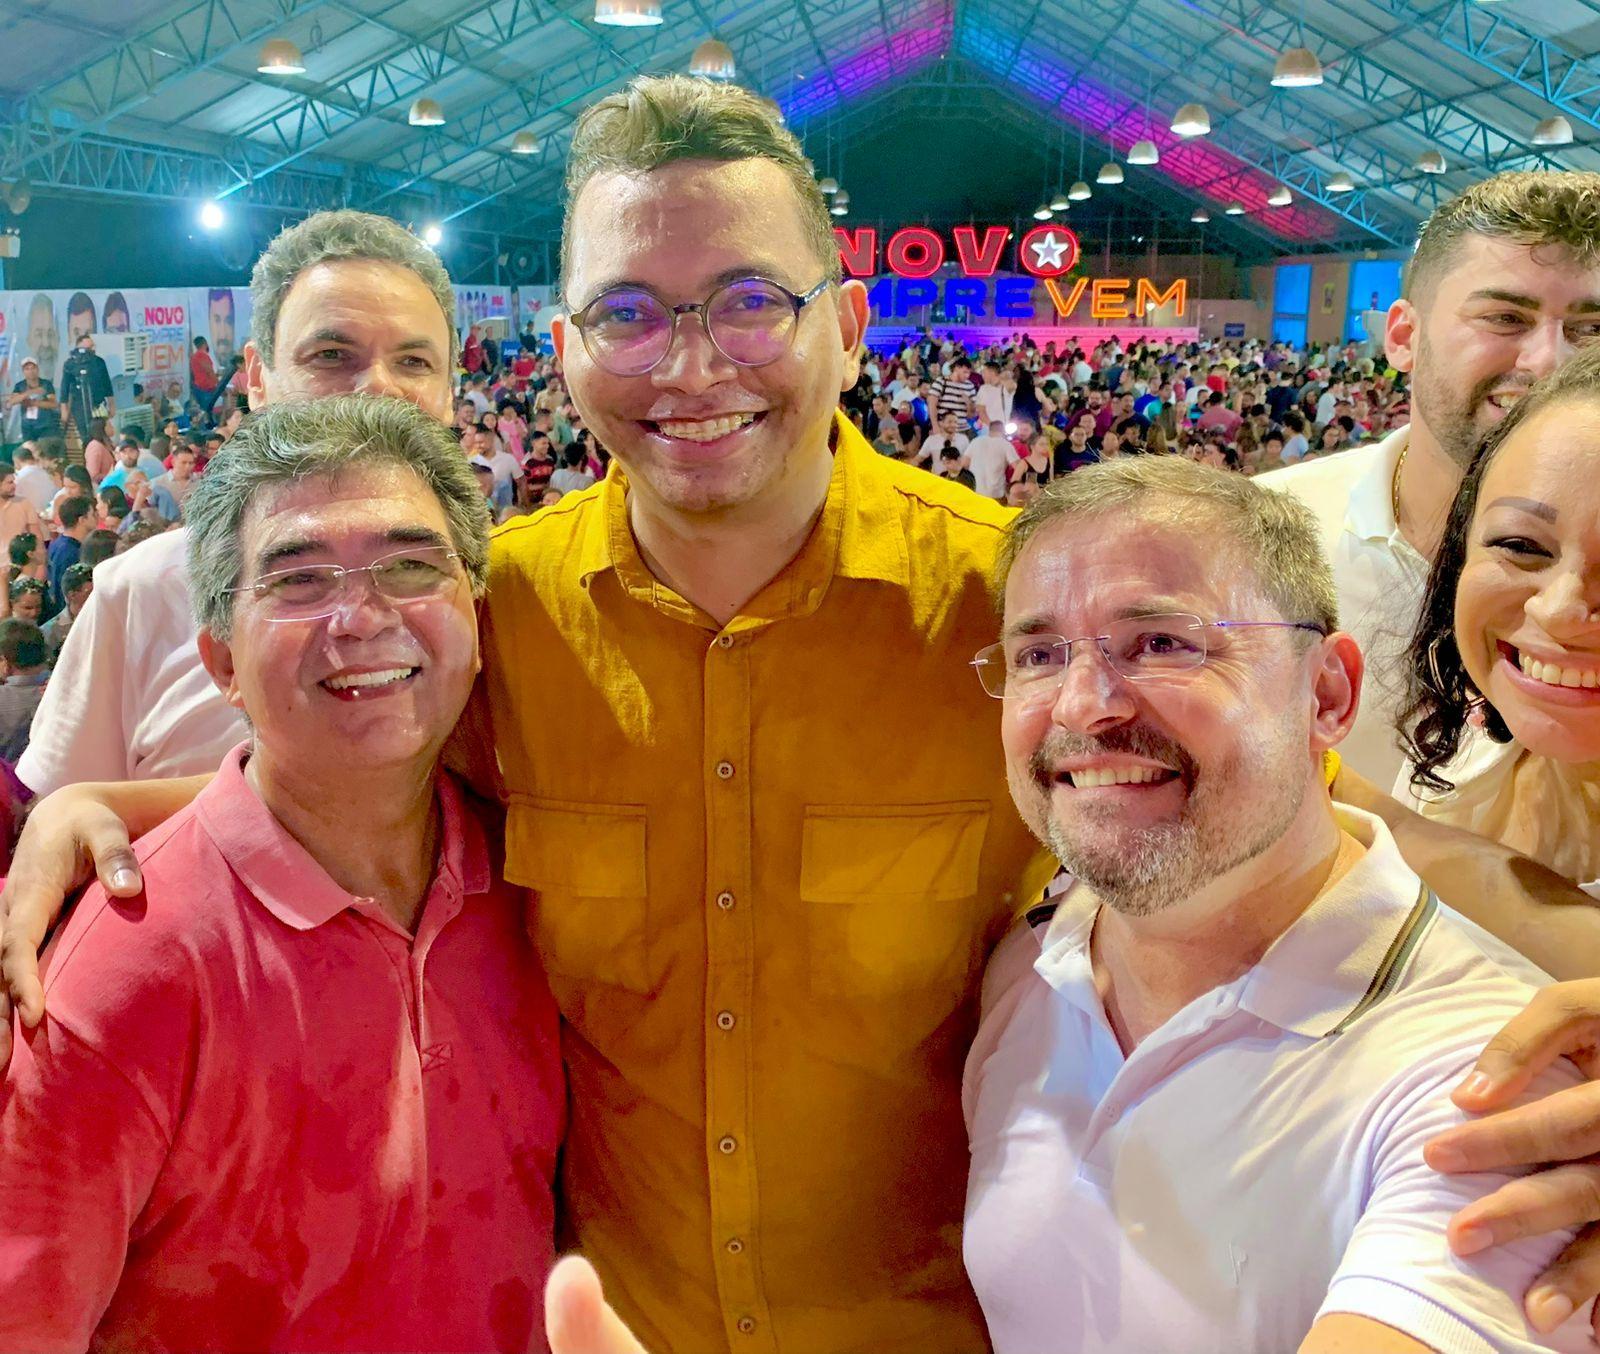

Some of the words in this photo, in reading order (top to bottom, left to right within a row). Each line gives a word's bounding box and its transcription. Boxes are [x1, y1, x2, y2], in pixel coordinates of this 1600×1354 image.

[832, 225, 1078, 278] NOVO
[144, 306, 184, 326] NOVO
[1043, 276, 1188, 318] VEM
